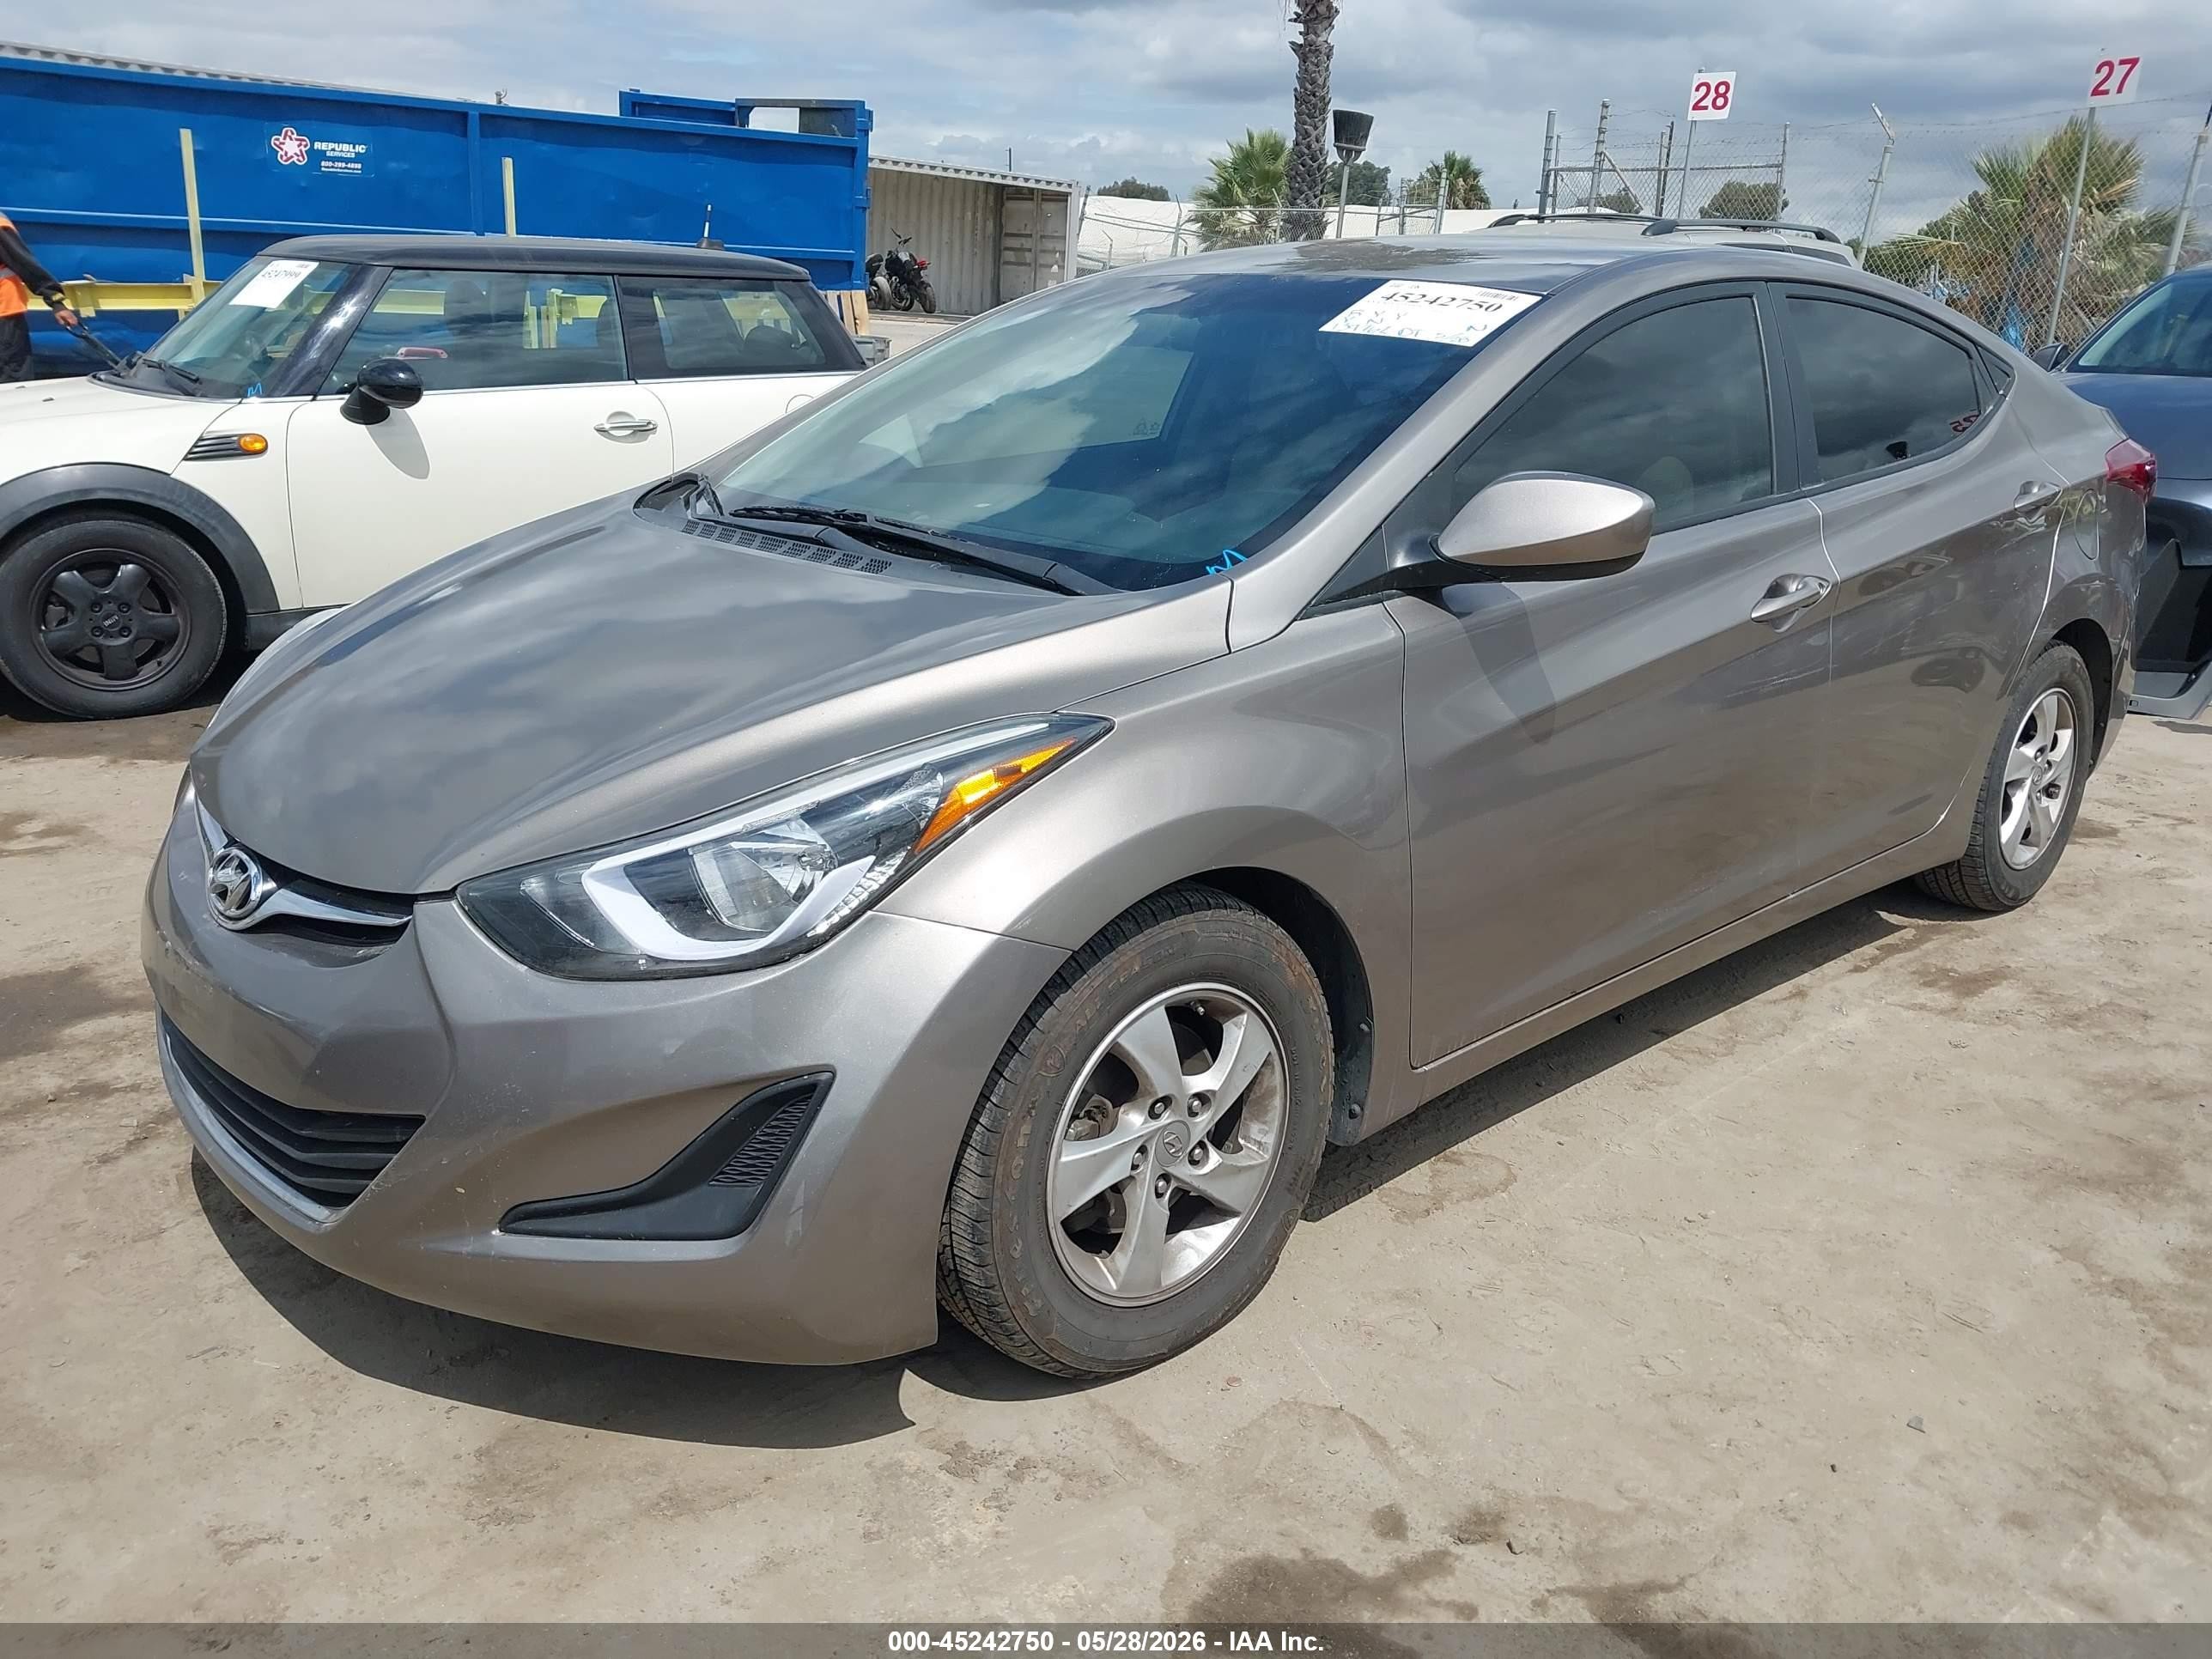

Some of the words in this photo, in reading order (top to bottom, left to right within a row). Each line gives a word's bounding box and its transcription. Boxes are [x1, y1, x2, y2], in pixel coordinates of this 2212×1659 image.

[2090, 57, 2141, 97] 27
[1692, 81, 1730, 111] 28
[313, 141, 367, 154] REPUBLIC
[1381, 291, 1503, 313] 45242750
